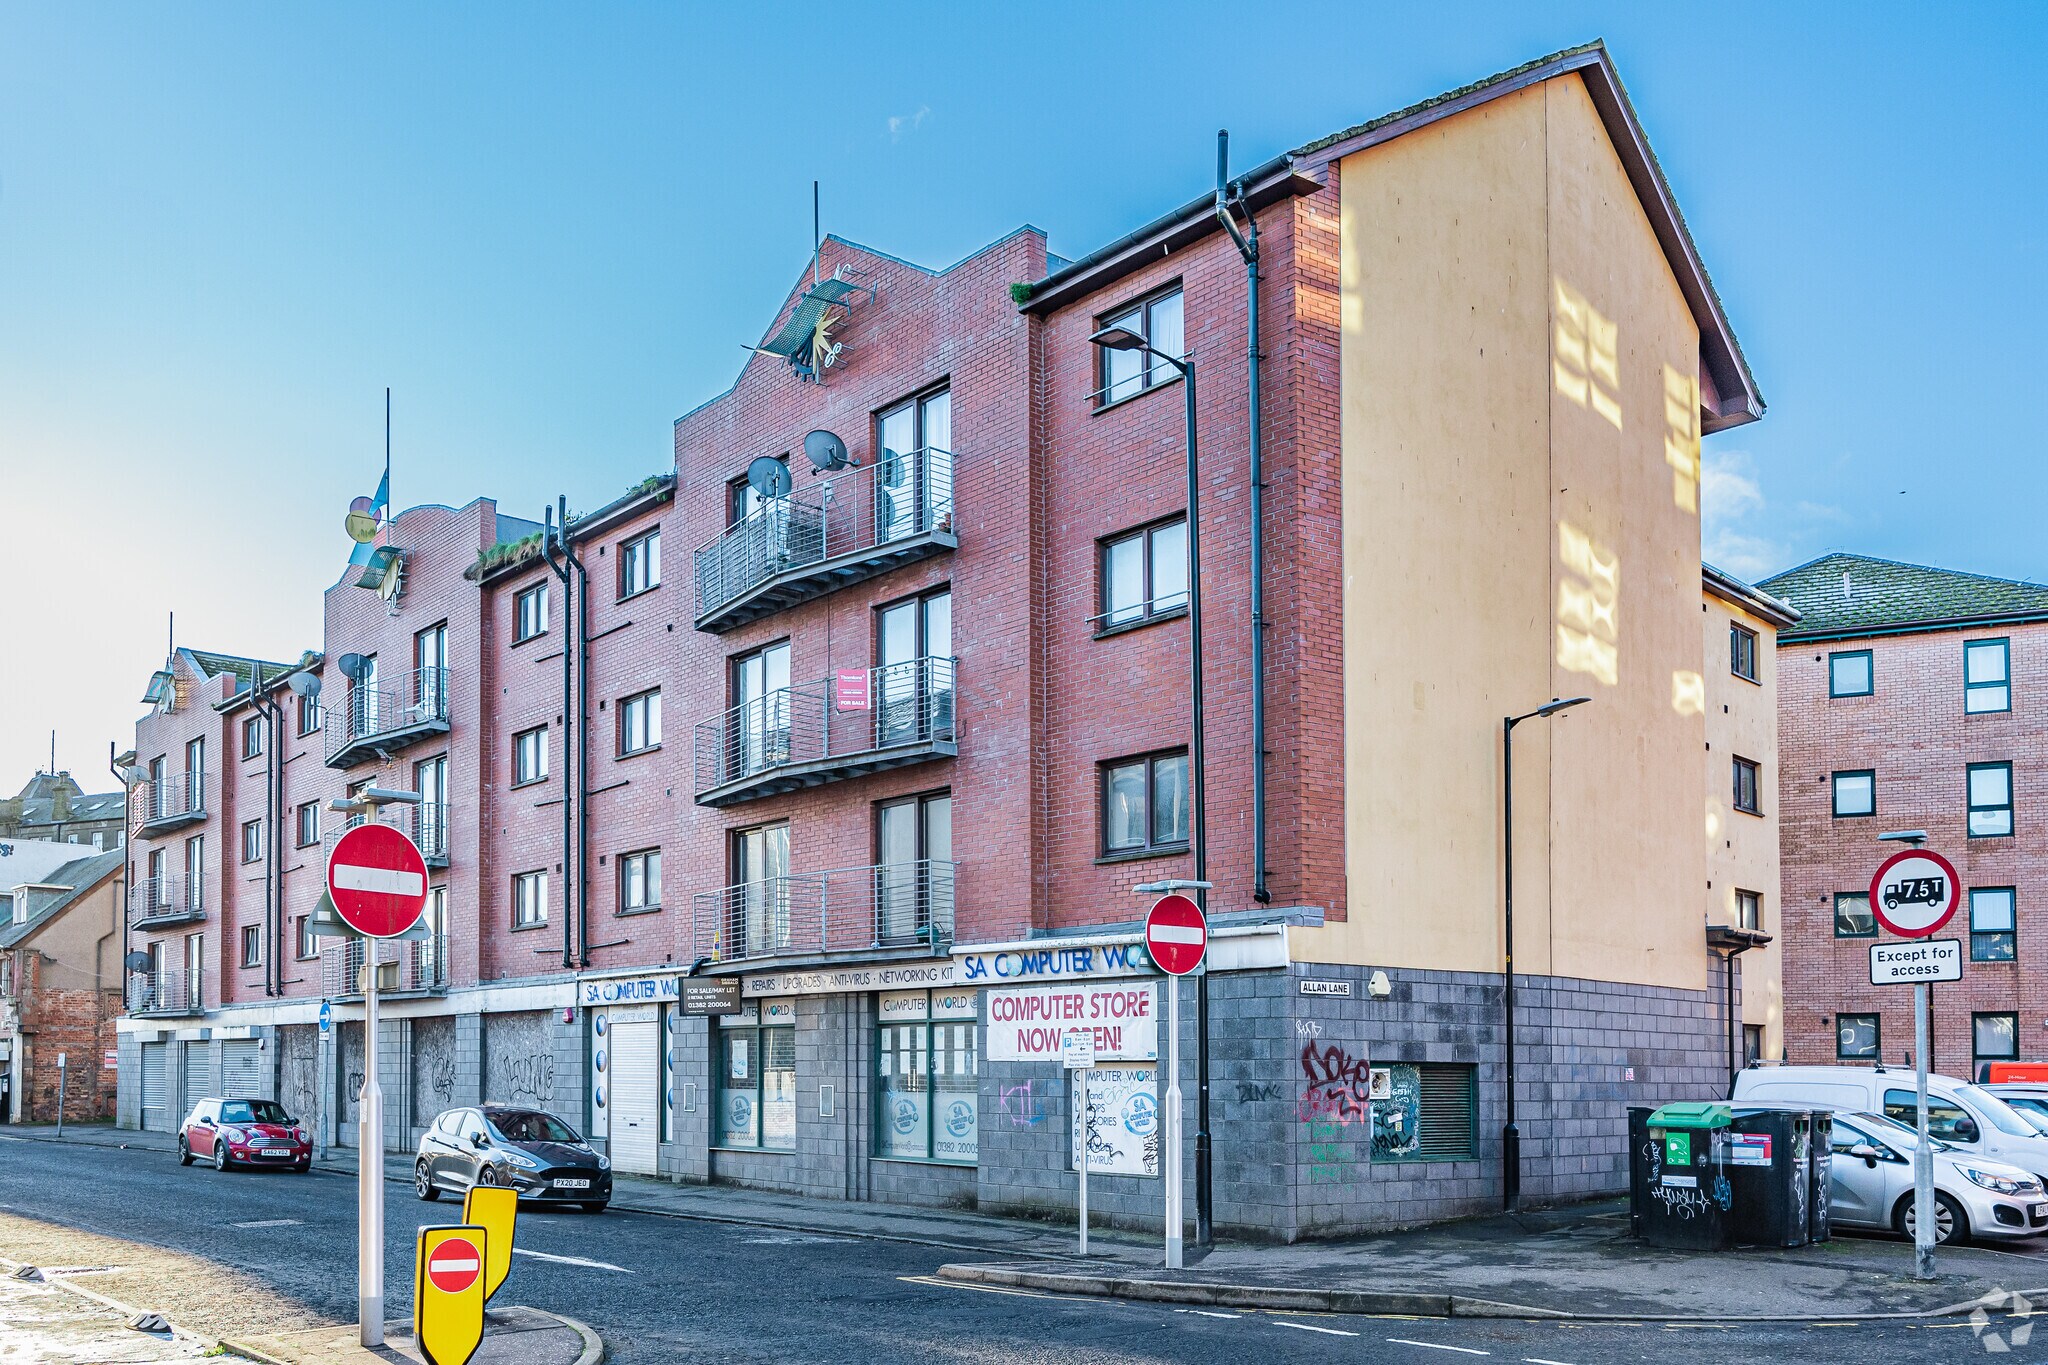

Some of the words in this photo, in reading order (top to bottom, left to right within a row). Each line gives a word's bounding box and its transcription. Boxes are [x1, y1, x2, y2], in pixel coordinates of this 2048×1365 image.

[964, 955, 988, 979] SA
[994, 947, 1094, 977] COMPUTER
[1102, 944, 1139, 970] WO
[1877, 948, 1927, 962] Except
[1932, 947, 1954, 959] for
[1891, 965, 1940, 977] access
[752, 978, 775, 991] REPAIRS
[783, 975, 821, 990] UPGRADES
[829, 972, 870, 986] ANTI-VIRUS
[879, 968, 938, 984] NETWORKING
[941, 966, 954, 980] KIT
[586, 984, 600, 1002] SA
[603, 980, 656, 1000] COMPUTER
[660, 977, 679, 996] WO
[1303, 982, 1326, 992] ALLAN
[1329, 984, 1348, 993] LANE
[763, 1005, 789, 1016] WORLD
[884, 998, 926, 1011] COMPUTER
[934, 996, 967, 1009] WORLD
[992, 994, 1085, 1022] COMPUTER
[1090, 990, 1150, 1019] STORE
[1017, 1028, 1062, 1053] NOW
[1068, 1026, 1122, 1051] EN!
[1074, 1070, 1122, 1082] CMPUTER
[1134, 1098, 1146, 1112] SA
[937, 1142, 954, 1152] 01382
[1075, 1155, 1113, 1165] ATI-VIRUS
